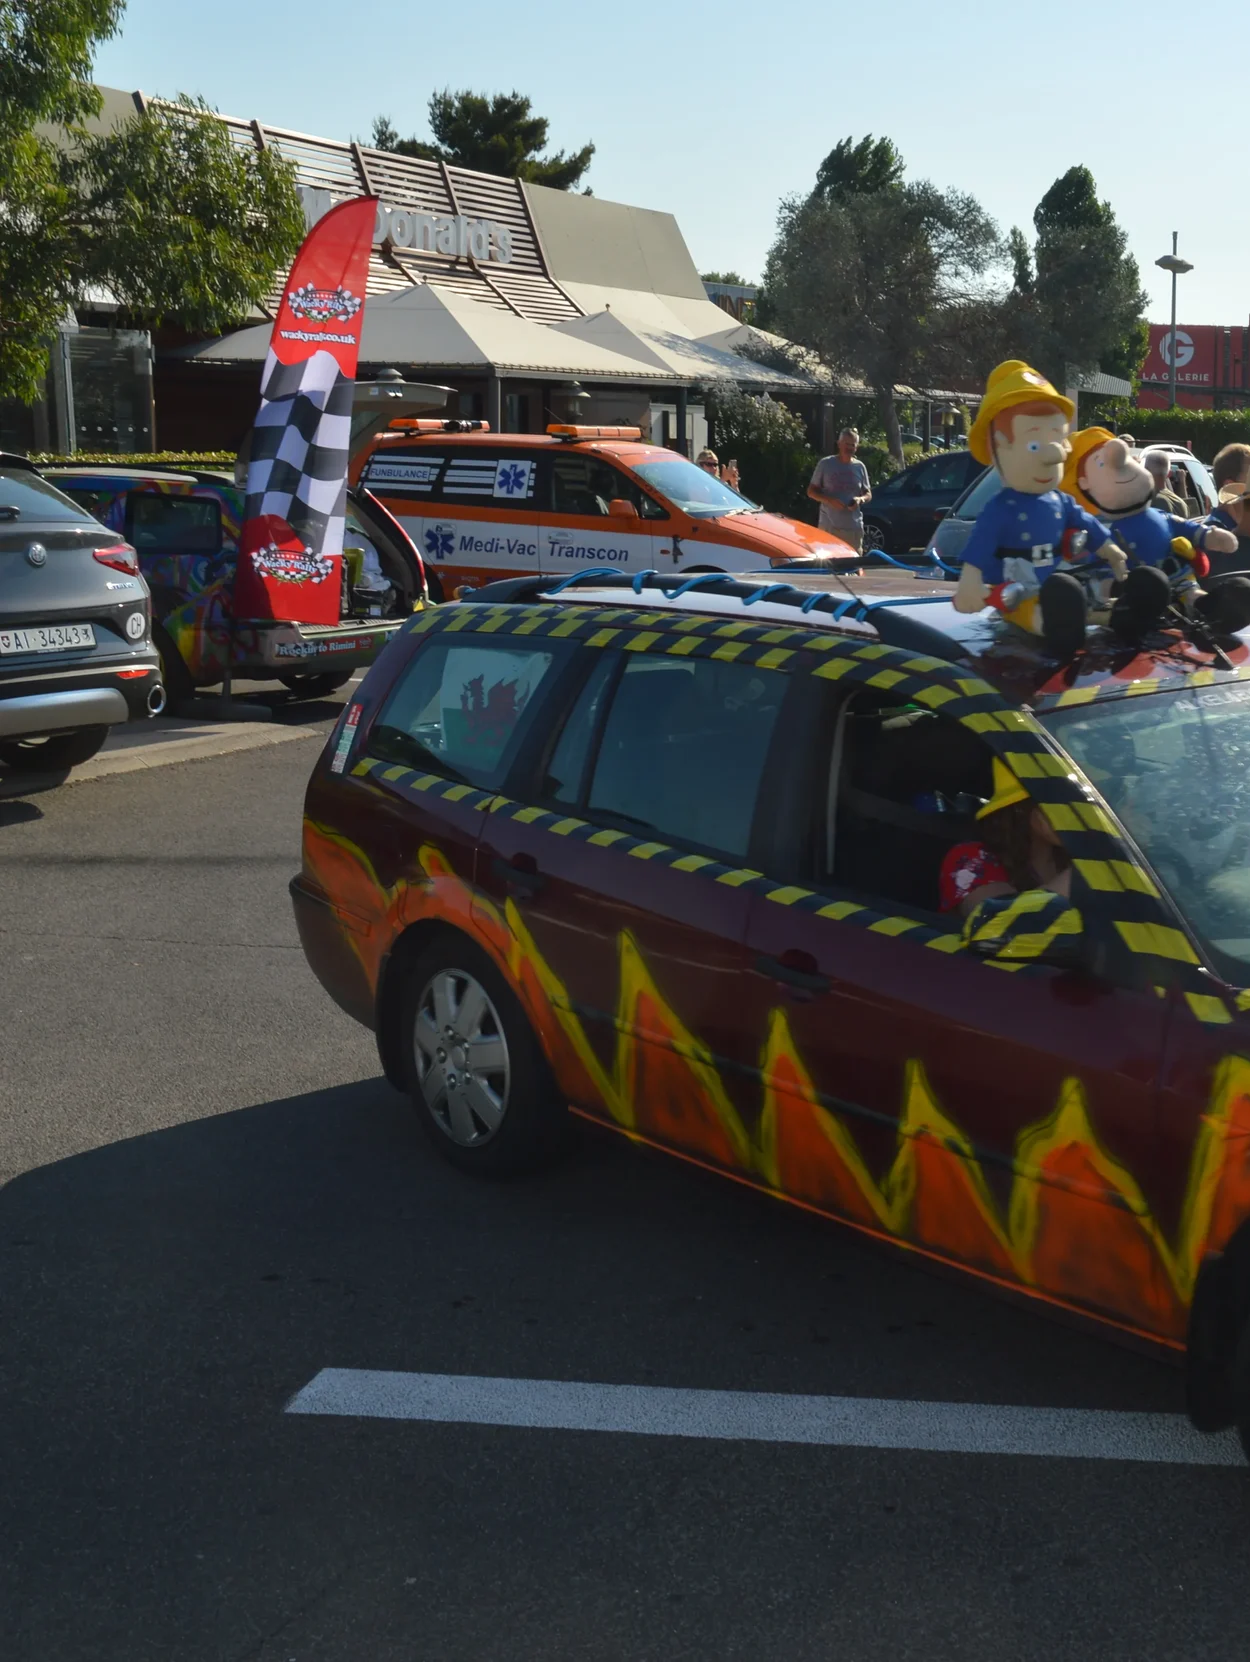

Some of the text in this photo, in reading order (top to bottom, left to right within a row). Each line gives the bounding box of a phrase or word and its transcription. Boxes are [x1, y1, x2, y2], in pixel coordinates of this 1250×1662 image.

[326, 300, 345, 311] Rlly
[1142, 372, 1209, 381] LA GLERIE
[370, 467, 428, 479] FUNBULANCE
[459, 535, 629, 562] Medi-Vac Transcon
[262, 559, 292, 569] Wacky
[131, 617, 142, 635] CH
[38, 627, 81, 648] 34343
[329, 640, 356, 651] Rimini
